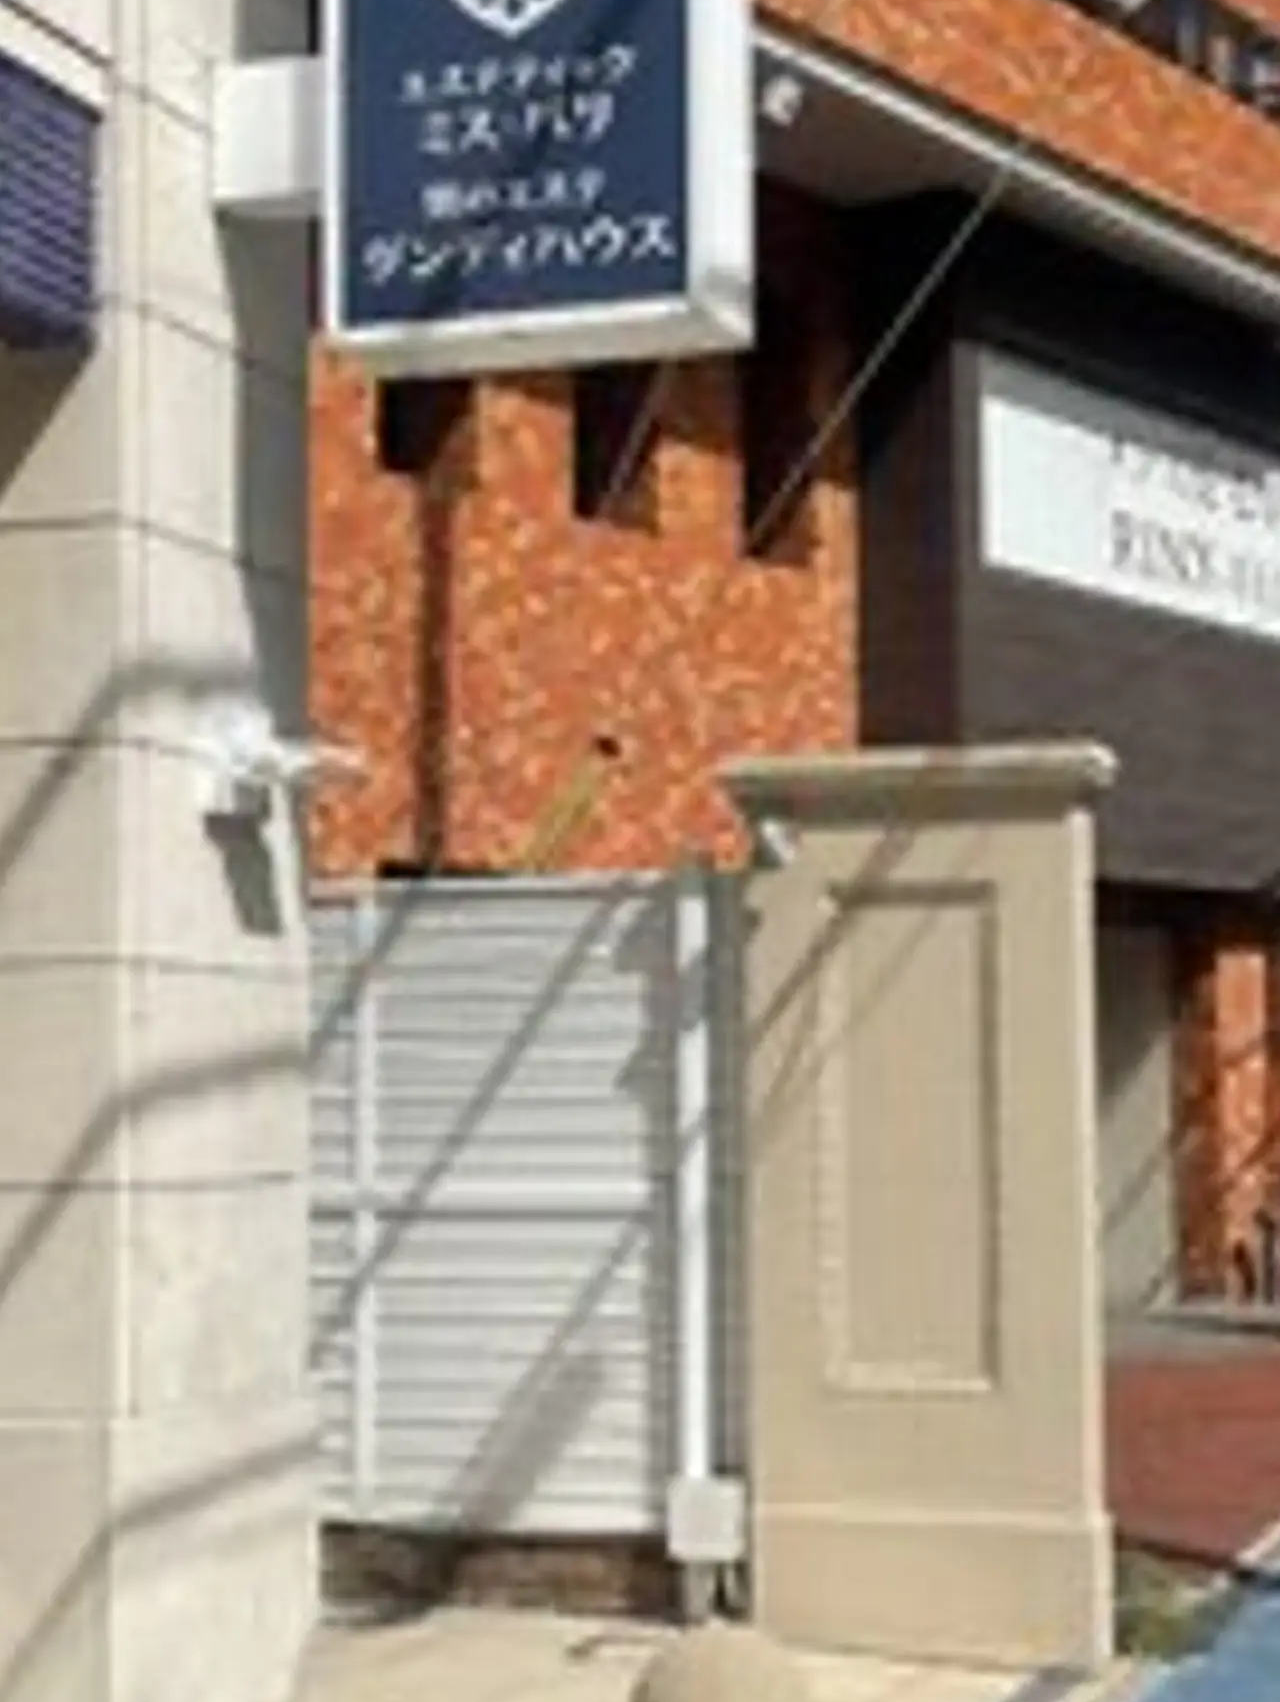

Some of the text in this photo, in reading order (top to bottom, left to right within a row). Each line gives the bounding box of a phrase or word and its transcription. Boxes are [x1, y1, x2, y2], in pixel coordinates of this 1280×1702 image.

[363, 213, 677, 287] ダンディハウス
